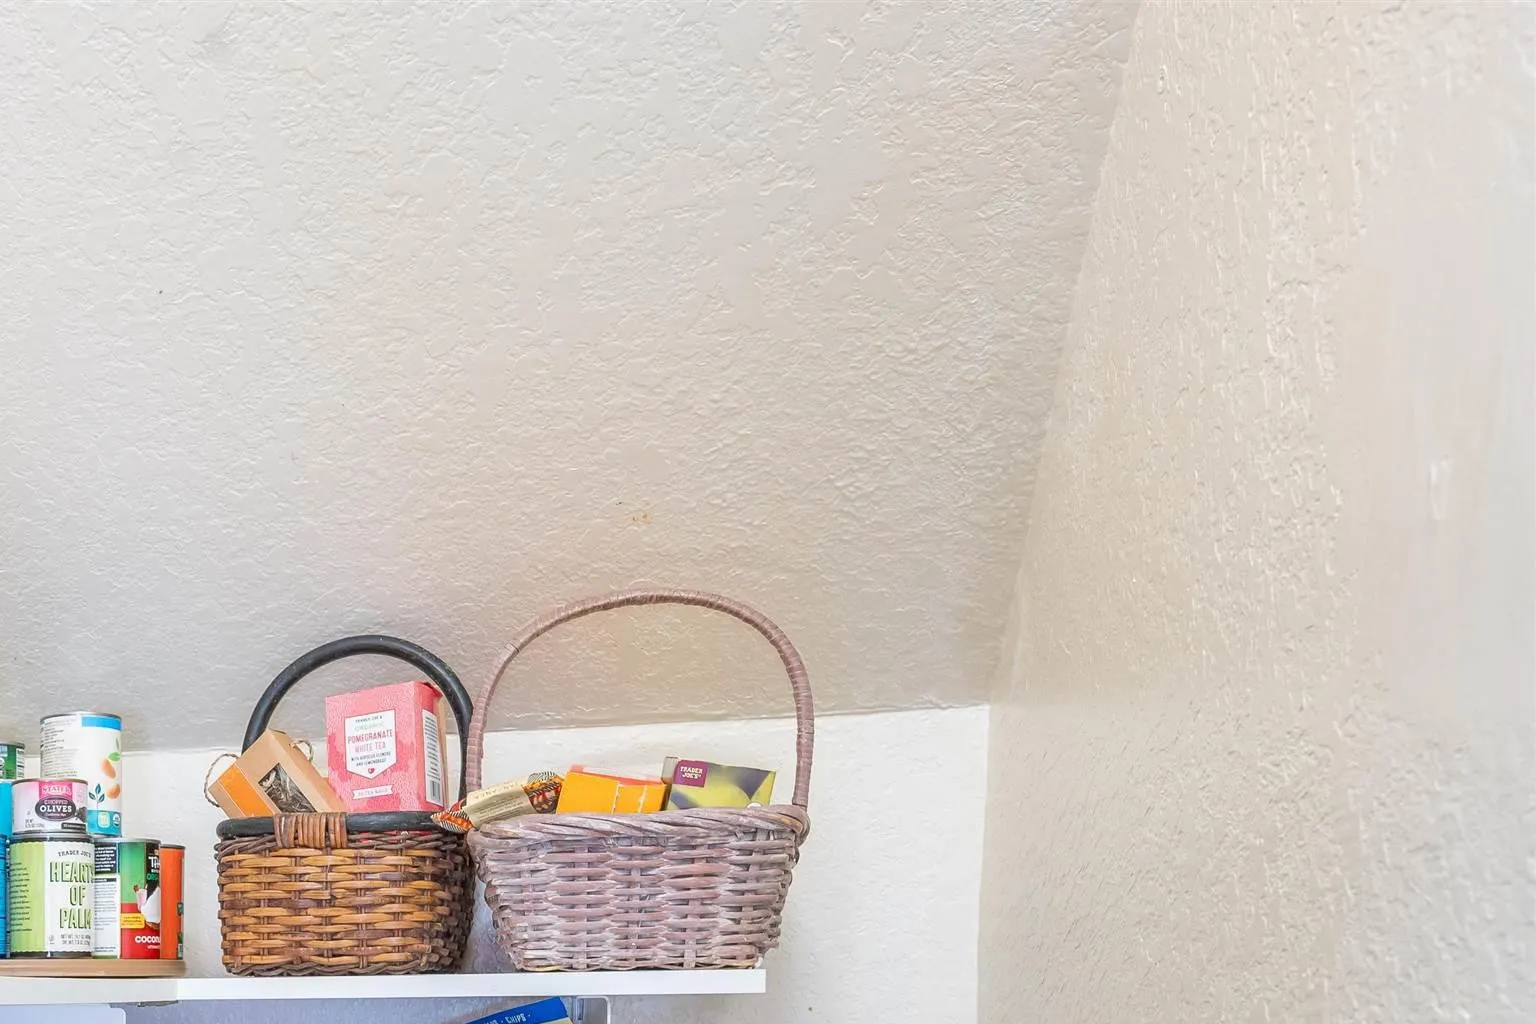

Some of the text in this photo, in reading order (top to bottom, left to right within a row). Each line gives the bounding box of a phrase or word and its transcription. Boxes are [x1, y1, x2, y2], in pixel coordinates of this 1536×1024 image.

[348, 729, 393, 744] POMEGRANATE
[680, 766, 703, 775] TRADER
[69, 887, 86, 905] OF
[59, 908, 92, 929] PALM
[505, 1013, 526, 1024] CHIPS
